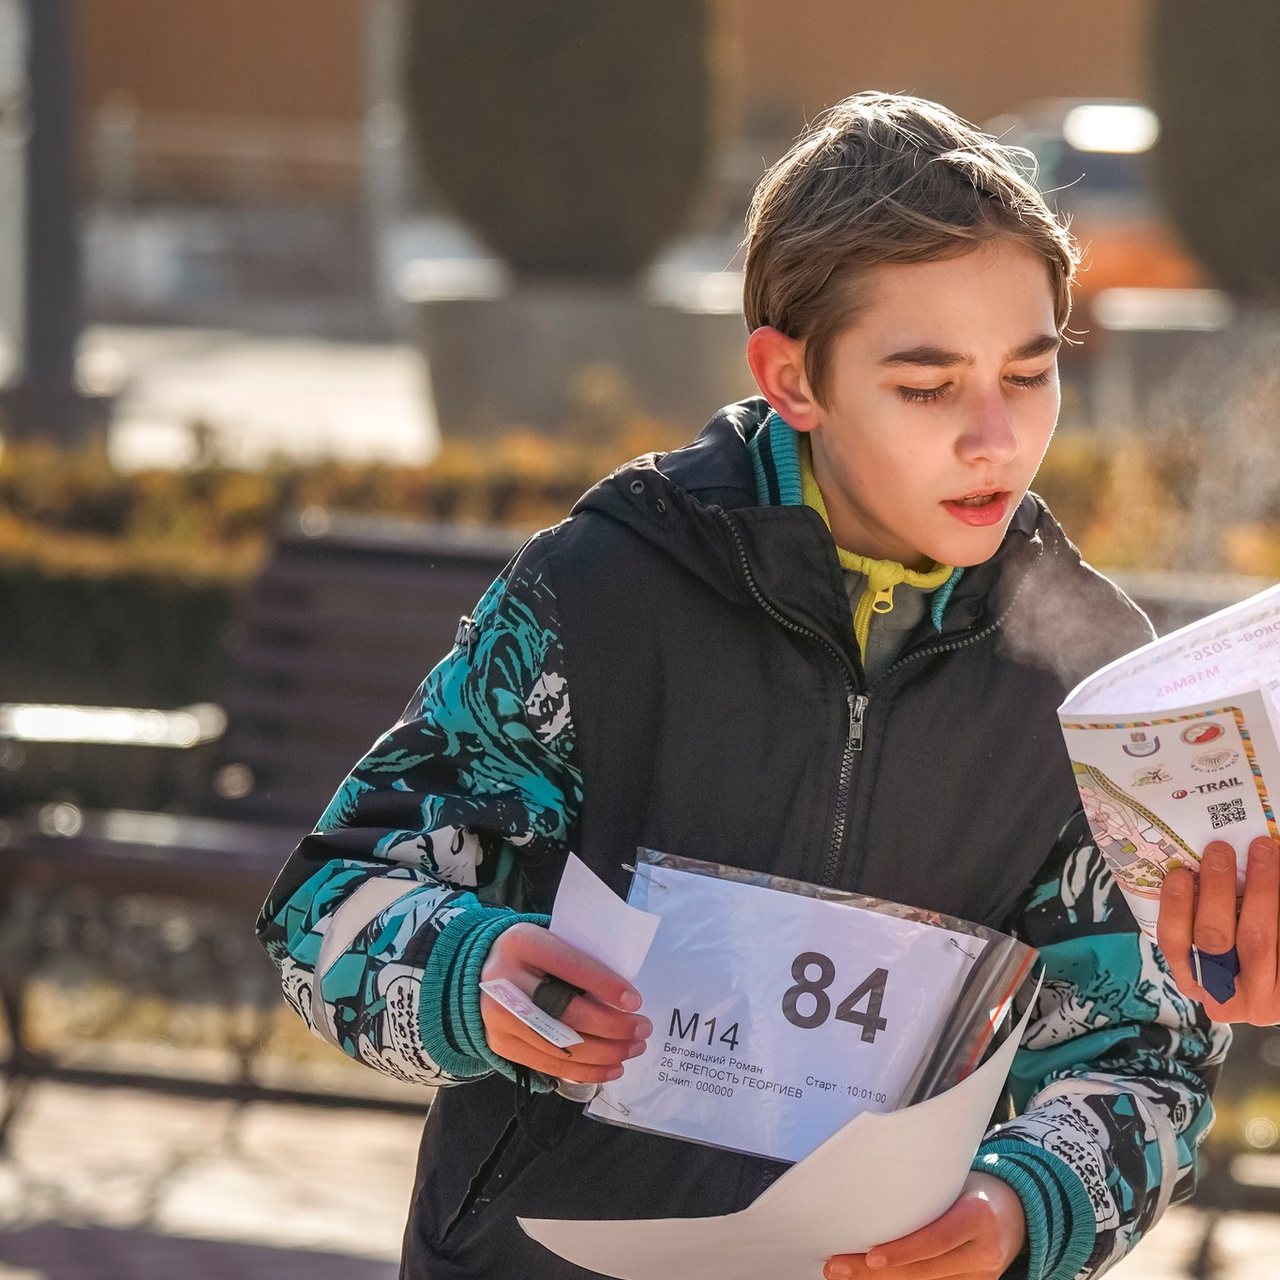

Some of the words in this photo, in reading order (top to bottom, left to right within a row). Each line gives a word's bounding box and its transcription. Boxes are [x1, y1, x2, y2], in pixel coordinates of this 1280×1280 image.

[781, 951, 889, 1044] 84
[663, 1042, 726, 1066] Беловицкий
[728, 1057, 763, 1075] Роман
[660, 1057, 740, 1085] 26_КРЕПОСТЬ
[742, 1077, 803, 1099] ГЕОРГИЕВ
[695, 1081, 734, 1098] 000000
[805, 1076, 837, 1092] Старт
[846, 1082, 887, 1104] 10:01:00
